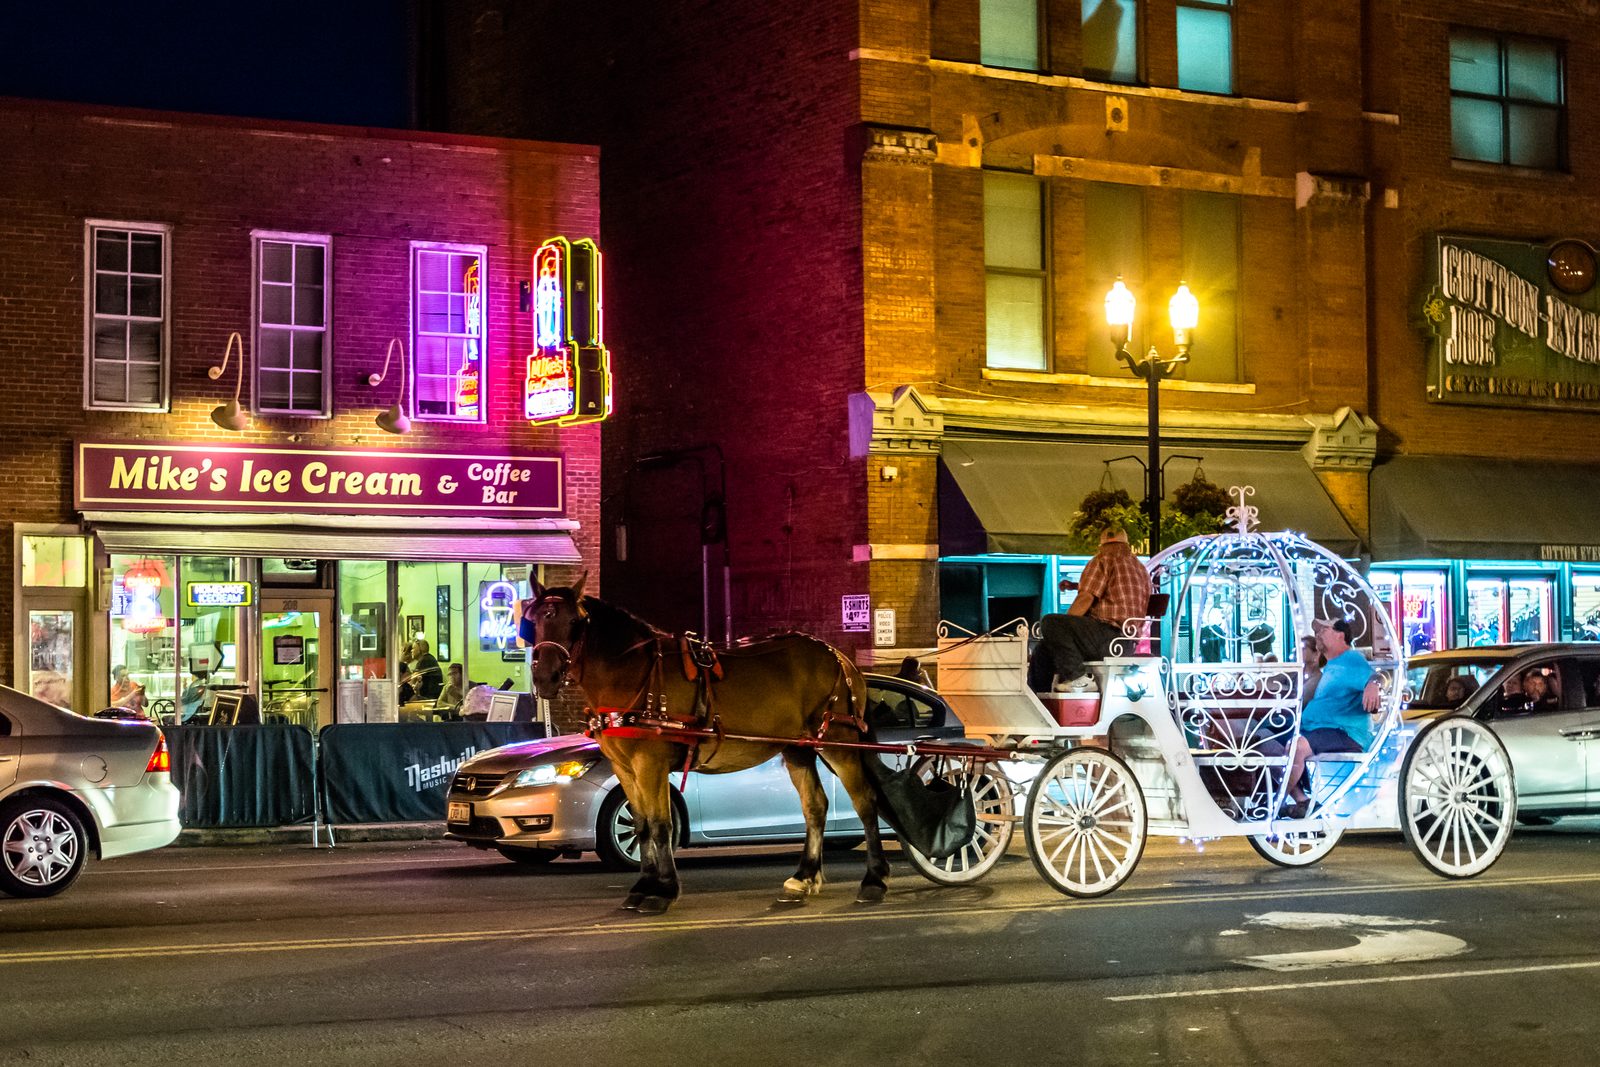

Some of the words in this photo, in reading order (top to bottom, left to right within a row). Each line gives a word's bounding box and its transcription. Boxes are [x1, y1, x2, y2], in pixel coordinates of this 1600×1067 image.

[1446, 305, 1496, 366] JOE
[109, 456, 228, 492] Mike's
[239, 459, 292, 493] Ice
[301, 462, 423, 497] Cream
[437, 475, 459, 494] &
[467, 463, 531, 486] Coffee
[482, 486, 518, 504] Bar
[1541, 545, 1577, 560] COTTON
[843, 600, 869, 610] T-SHIRTS
[404, 745, 477, 792] Nashvill
[422, 776, 447, 790] MUSIC
